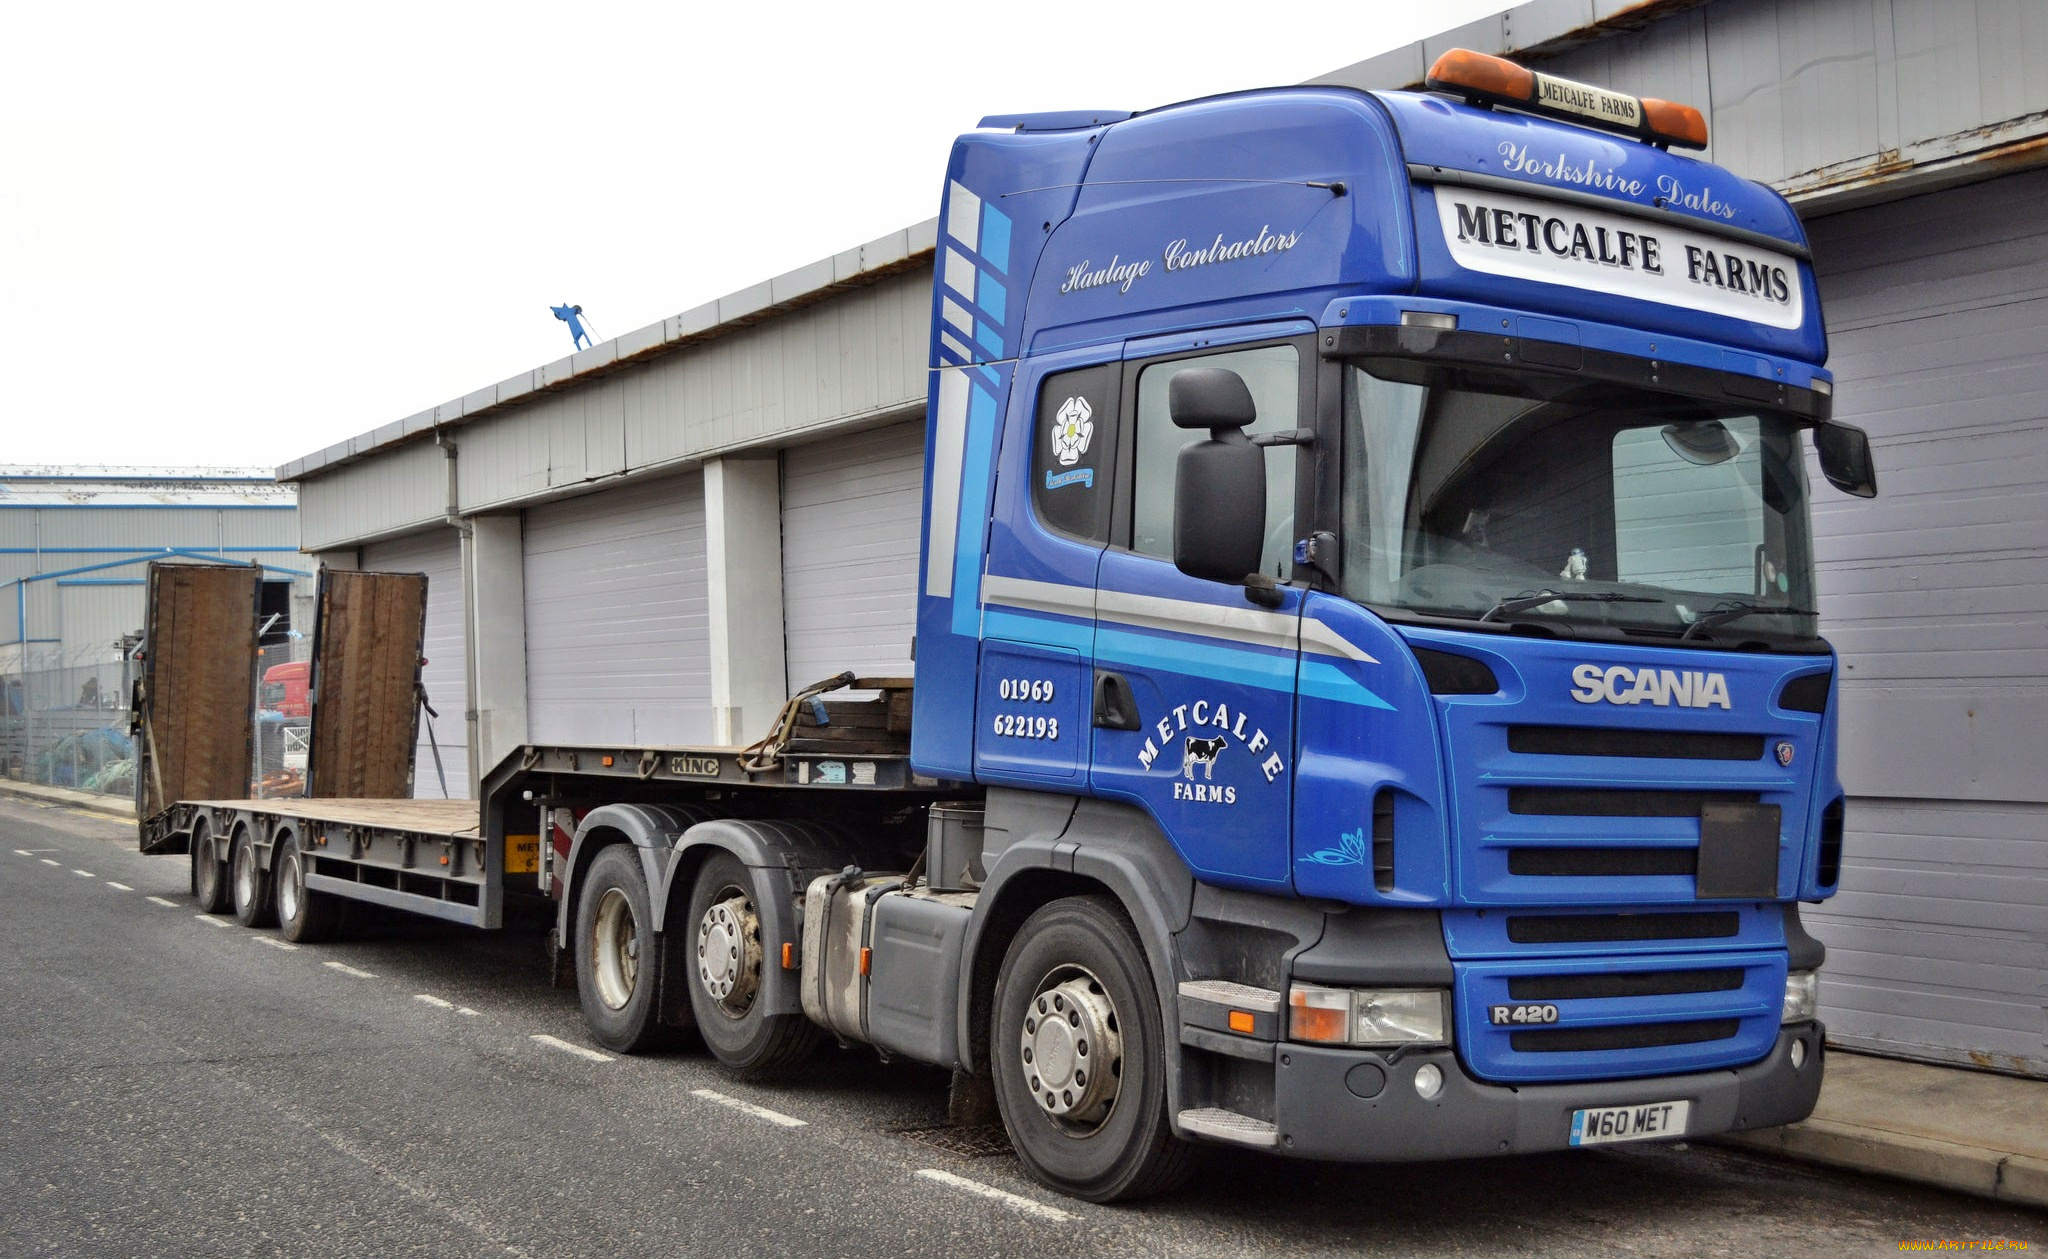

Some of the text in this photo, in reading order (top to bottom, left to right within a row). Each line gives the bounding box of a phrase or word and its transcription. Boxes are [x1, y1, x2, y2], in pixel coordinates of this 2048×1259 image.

[1542, 81, 1635, 119] METCALFE FARMS
[1498, 141, 1737, 219] Yorkshire Dales
[1060, 224, 1302, 294] Haulage Contractors
[1454, 203, 1790, 304] METCALFE FARMS
[999, 678, 1054, 702] 01969
[1570, 664, 1731, 710] SCANIA
[993, 714, 1058, 739] 622193
[1137, 700, 1284, 783] METCALFE
[674, 757, 717, 775] KING
[1173, 782, 1237, 804] FARMS
[1493, 1005, 1558, 1024] R 420
[1586, 1105, 1673, 1137] W60 MET
